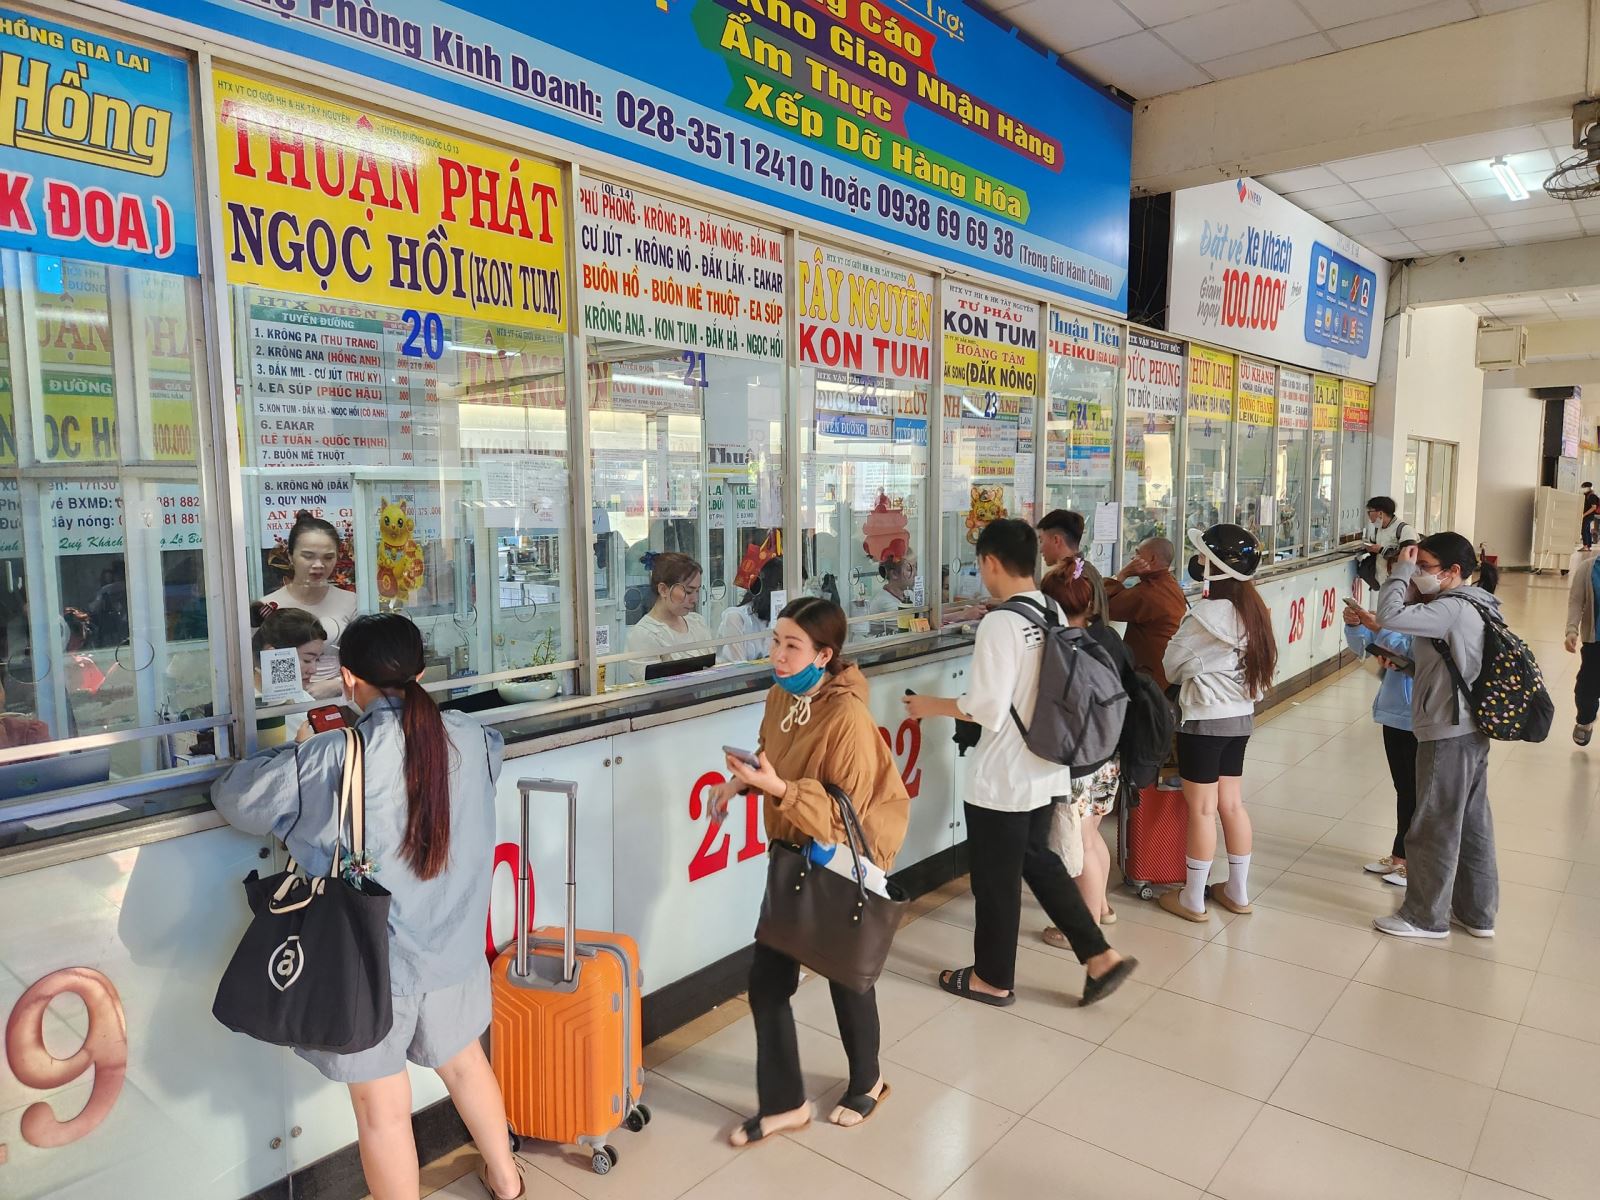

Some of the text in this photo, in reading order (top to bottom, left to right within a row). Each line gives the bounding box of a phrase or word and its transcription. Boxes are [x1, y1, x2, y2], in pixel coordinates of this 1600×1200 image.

[860, 2, 922, 58] Cáo
[71, 38, 112, 63] GIA
[115, 50, 150, 74] LAI
[720, 12, 892, 123] Ẩm Thực
[217, 80, 233, 92] HTX
[235, 85, 245, 97] VT
[830, 25, 907, 87] Giao
[917, 71, 990, 131] Nhận
[997, 113, 1056, 166] Hàng
[0, 50, 173, 178] Hồng
[310, 0, 421, 59] Phòng
[432, 25, 502, 83] Kinh
[511, 54, 603, 118] Doanh:
[617, 90, 814, 192] 028-35112410
[822, 166, 871, 213] hoặc
[878, 183, 930, 231] 0938
[936, 206, 961, 242] 69
[966, 216, 988, 251] 69
[993, 227, 1014, 259] 38
[1019, 244, 1048, 272] (Trong
[1050, 255, 1064, 275] Giờ
[1066, 261, 1086, 283] Hành
[744, 75, 1022, 218] Xếp Dỡ Hàng Hóa
[437, 157, 559, 244] PHÁT
[601, 182, 634, 200] (QL.14)
[48, 181, 172, 255] ĐOA)
[602, 192, 636, 225] PHONG
[643, 203, 677, 236] KRÔNG
[679, 215, 691, 239] PA
[699, 213, 718, 246] ĐẮK
[720, 223, 743, 253] NÔNG
[750, 227, 767, 259] ĐẮK
[769, 239, 783, 264] MIL
[227, 202, 562, 324] NGỌC HỒI (KON TUM)
[581, 223, 783, 294] CƯ JÚT KRÔNG NÔ ĐẮK LẮK EAKAR
[1229, 232, 1245, 266] vé
[1245, 226, 1260, 267] Xe
[1261, 229, 1293, 275] khách
[257, 295, 311, 311] HTX
[583, 261, 783, 325] BUÔN HỒ BUÔN MÊ THUỘT EA SÚP
[800, 246, 933, 342] TÂY NGUYÊN
[949, 285, 963, 295] HTX
[958, 299, 980, 312] TƯ
[1197, 300, 1220, 328] ngay
[320, 316, 355, 330] ĐƯỜNG
[401, 309, 444, 361] 20
[584, 301, 783, 360] KRÔNG ANA KON TUM ĐẮK HÀ NGỌC HỒI
[944, 309, 988, 339] KON
[995, 321, 1037, 350] TUM
[267, 327, 379, 351] KRÔNG PA (THU TRANG)
[800, 322, 929, 381] KON TUM
[267, 345, 381, 368] KRÔNG ANA ANH)
[956, 342, 1026, 366] HOÀNG TÂM
[290, 367, 366, 382] MIL JÚT (THƯ
[681, 350, 709, 388] 21
[966, 360, 1037, 396] (ĐẮK NÔNG)
[1148, 359, 1181, 388] PHONG
[1212, 362, 1232, 390] LINH
[269, 381, 382, 401] EA SÚP (PHÚC HẬU)
[984, 391, 998, 419] 23
[282, 403, 297, 414] TUM
[276, 420, 315, 431] EAKAR
[260, 432, 388, 449] (LÊ TUẤN QUỐC THỊNH)
[273, 449, 345, 461] BUÔN THUỘT
[276, 479, 324, 491] KRÔNG NÔ
[68, 497, 113, 509] BXMĐ:
[180, 496, 200, 508] 882
[277, 495, 327, 506] QUY NHƠN
[77, 515, 115, 529] nóng:
[181, 513, 200, 524] 881
[267, 510, 288, 521] AN
[58, 535, 124, 551] Quý Khách
[1288, 596, 1305, 645] 28
[1320, 586, 1336, 630] 29
[878, 717, 922, 800] 2
[688, 771, 767, 883] 21
[0, 967, 128, 1166] 9
